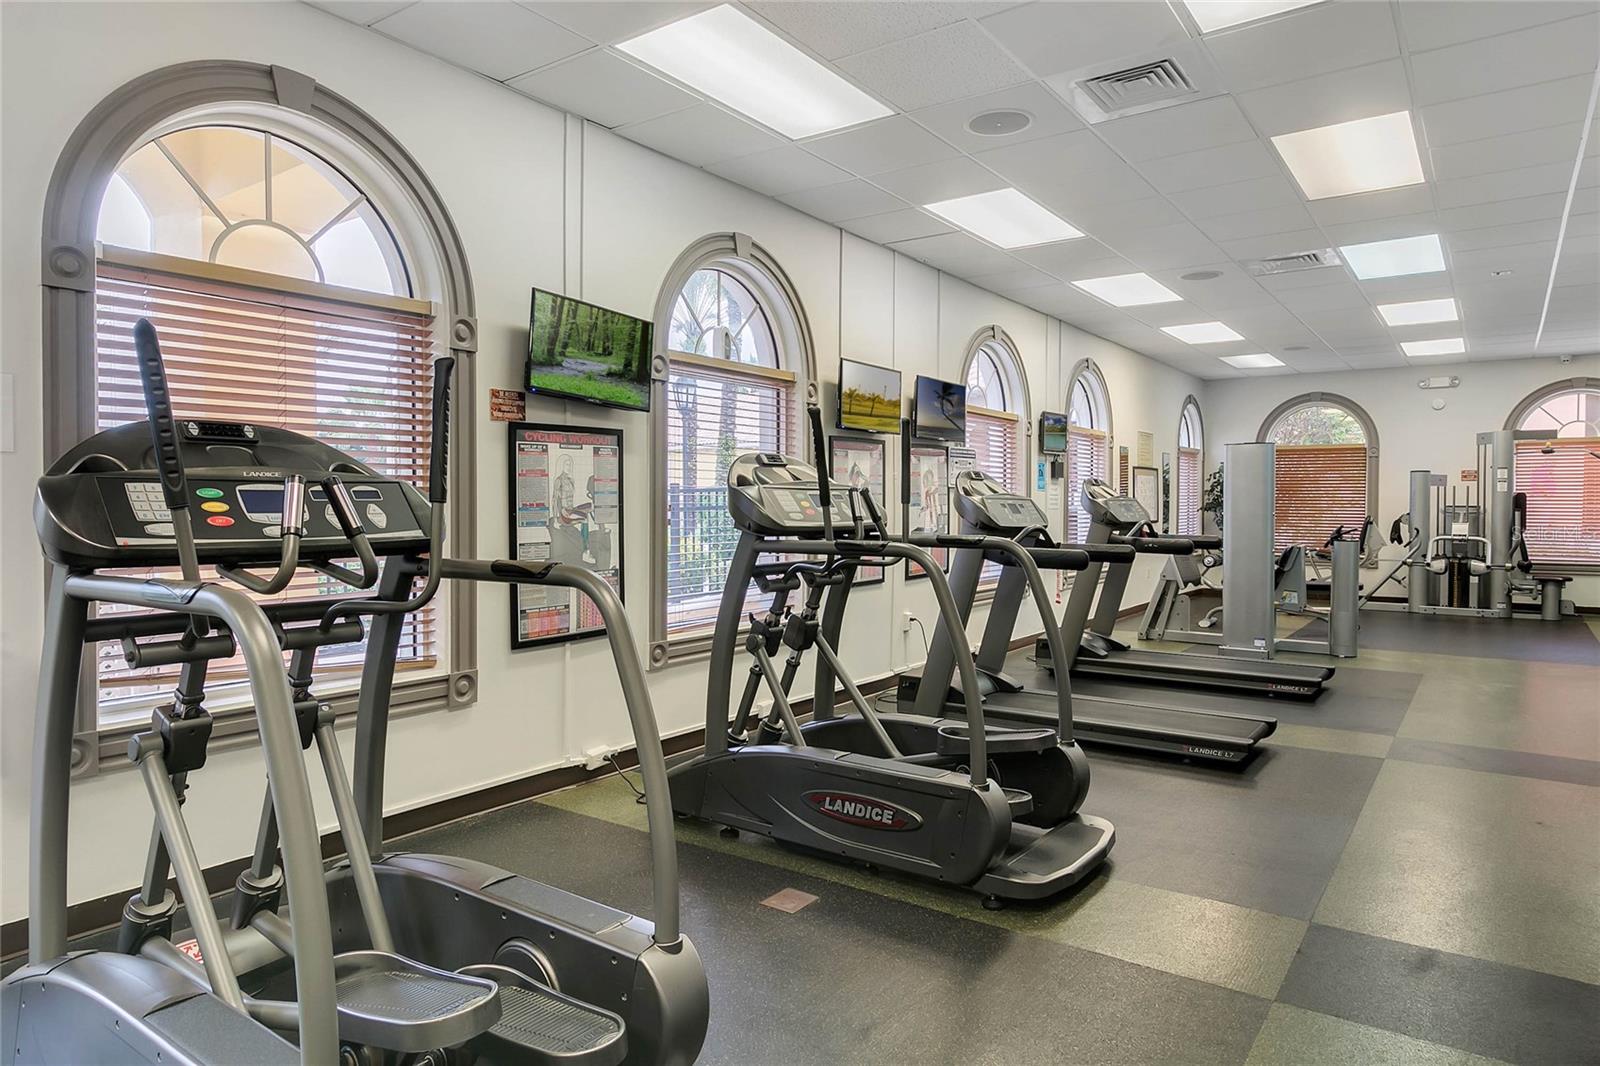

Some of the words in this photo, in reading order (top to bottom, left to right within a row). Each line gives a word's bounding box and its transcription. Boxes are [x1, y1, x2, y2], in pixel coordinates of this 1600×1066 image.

[524, 432, 567, 443] CYCLING
[569, 434, 611, 445] WORKOUT
[1272, 684, 1300, 692] LANDICE
[1189, 747, 1223, 757] LANDICE
[824, 797, 894, 825] LANDICE
